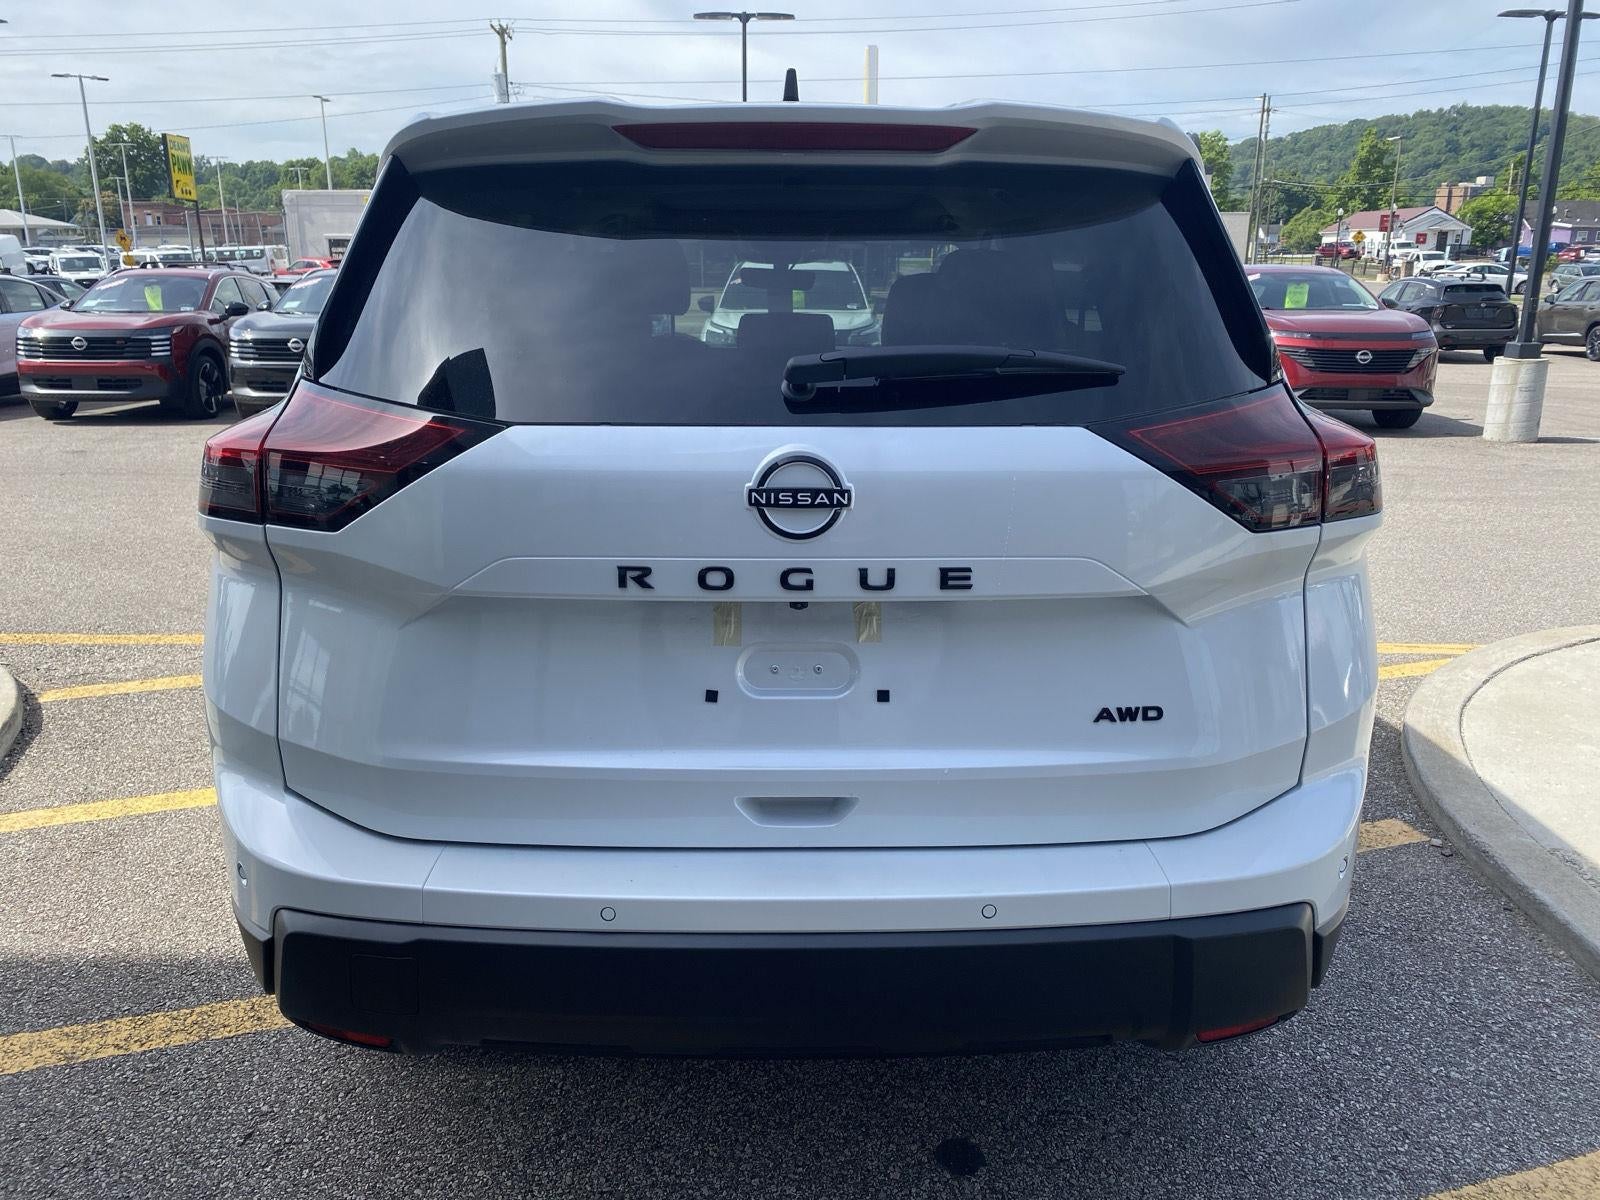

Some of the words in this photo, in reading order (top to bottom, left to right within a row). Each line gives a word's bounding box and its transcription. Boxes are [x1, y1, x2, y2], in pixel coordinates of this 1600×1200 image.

[171, 151, 193, 177] PAWN
[751, 491, 849, 505] NISSAN
[616, 565, 974, 592] ROGUE
[1093, 705, 1164, 723] AWD
